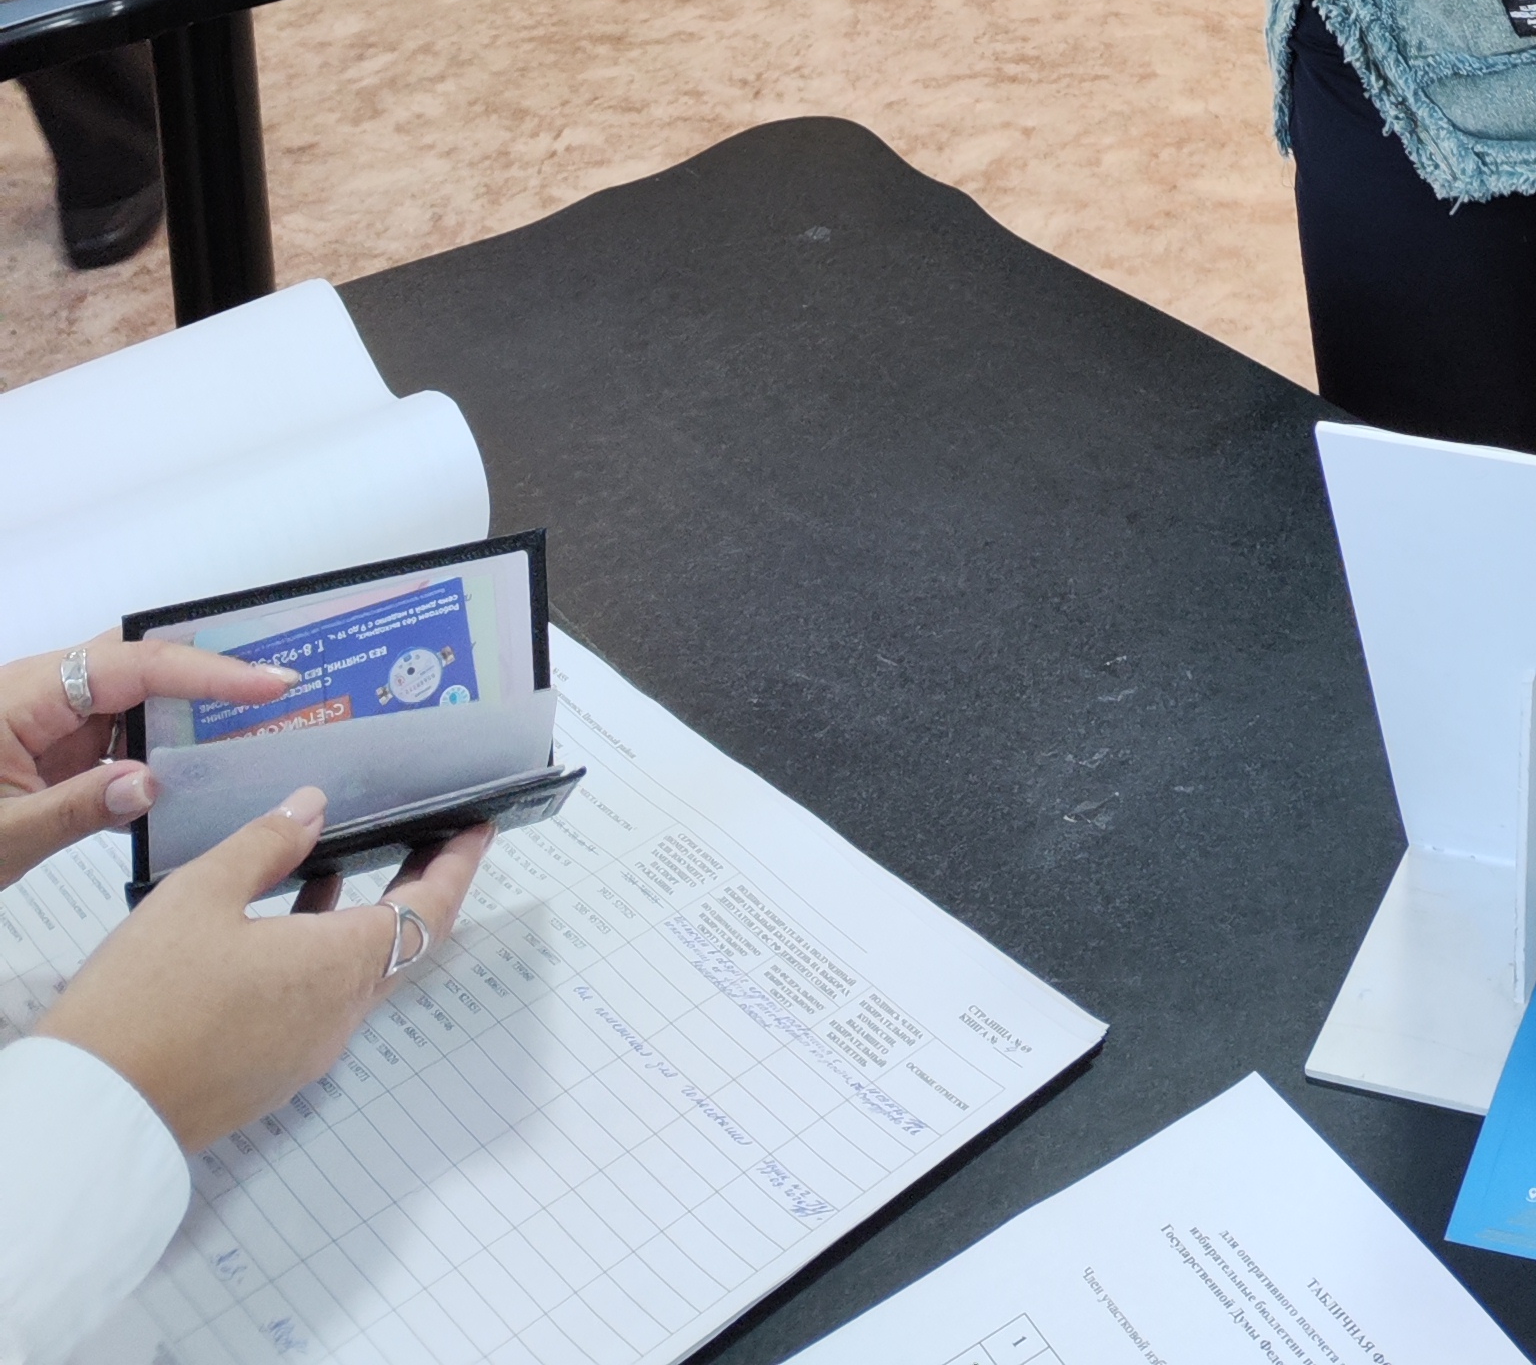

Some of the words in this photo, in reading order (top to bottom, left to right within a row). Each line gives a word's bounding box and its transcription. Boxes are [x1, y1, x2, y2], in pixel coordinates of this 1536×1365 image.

[400, 614, 417, 627] без
[416, 601, 460, 622] Работаем
[322, 653, 362, 674] СНЯТИЯ,
[362, 645, 387, 661] БЕЗ
[957, 1010, 990, 1039] КНИГА
[966, 1002, 1013, 1042] СТРАНИЦА
[1155, 1221, 1238, 1312] Государственной
[1225, 1304, 1264, 1344] Думы
[1184, 1223, 1259, 1306] избирательные
[1251, 1297, 1309, 1361] бюллетени
[1217, 1226, 1241, 1252] для
[1232, 1246, 1300, 1321] оперативного
[1292, 1313, 1341, 1365] подсчета
[1077, 1264, 1108, 1296] Член
[1095, 1290, 1152, 1353] участковой
[1304, 1276, 1376, 1355] ТАБЛИЧНАЯ
